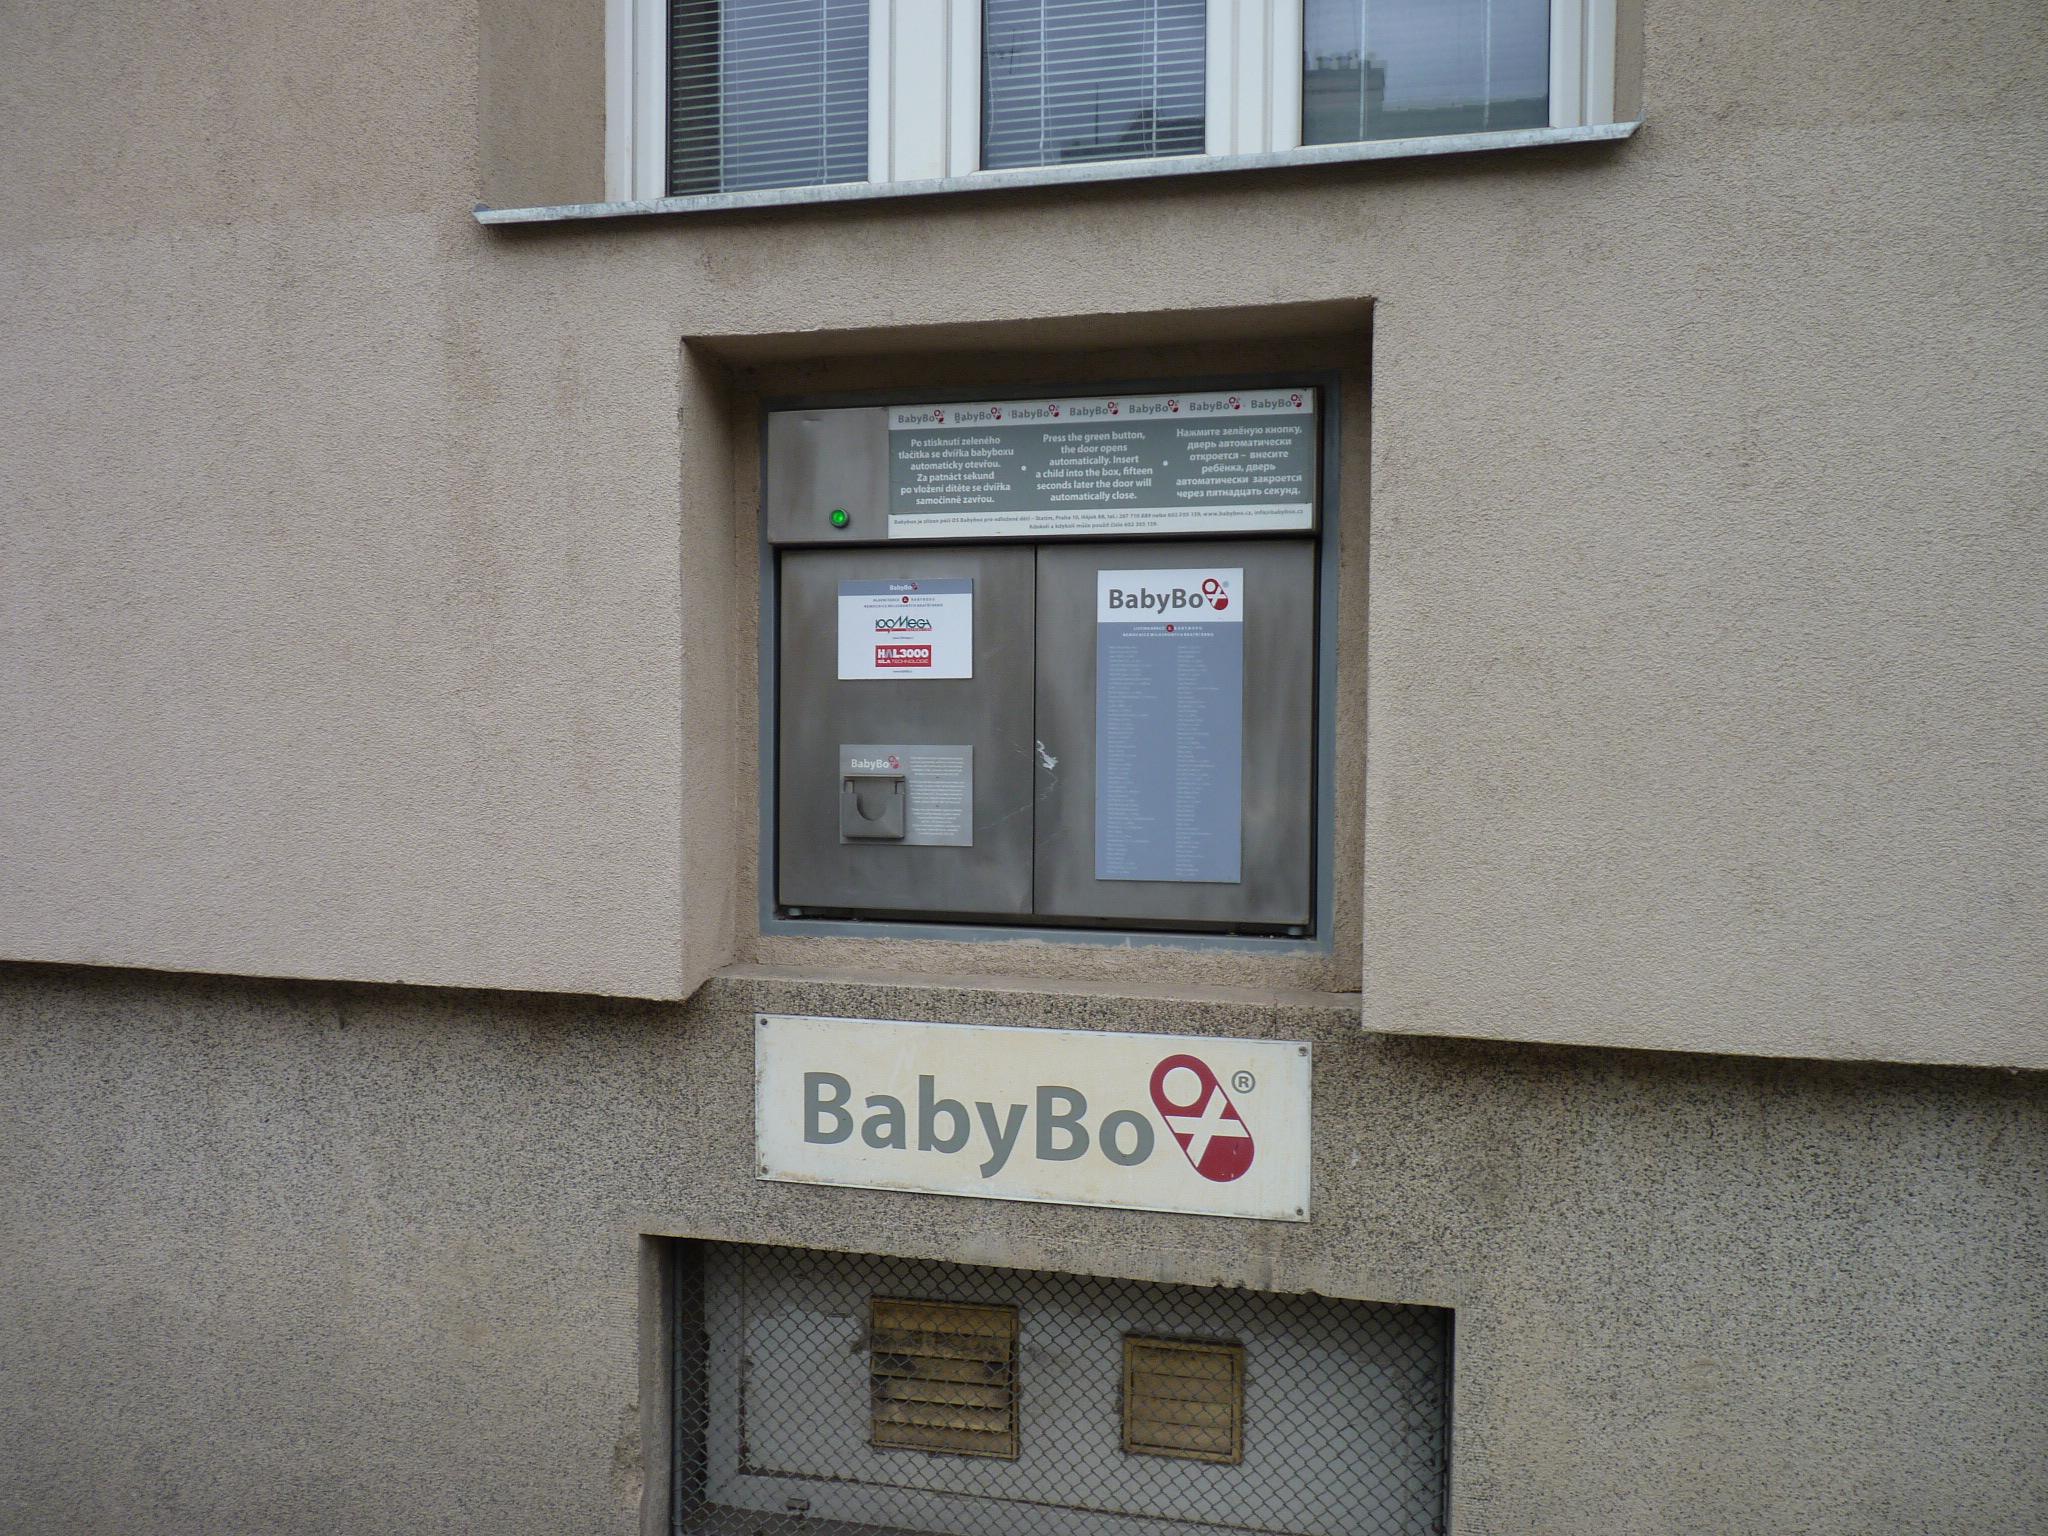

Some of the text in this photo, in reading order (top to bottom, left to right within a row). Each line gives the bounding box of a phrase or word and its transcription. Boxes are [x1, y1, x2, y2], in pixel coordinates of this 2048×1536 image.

[1177, 428, 1220, 436] Нажмите
[1222, 426, 1263, 436] зелёную
[911, 436, 1000, 447] Po stisknutí zeleného
[1043, 434, 1066, 443] Press
[1084, 433, 1110, 442] green
[1112, 431, 1145, 440] button,
[1061, 444, 1127, 454] the door opens
[1187, 439, 1292, 450] дверь автоматически
[899, 450, 929, 459] tlačítka
[942, 449, 969, 457] dvířka
[971, 448, 1014, 457] babyboxu
[1190, 453, 1238, 462] откроется
[910, 460, 1000, 470] automaticky otevřou.
[1049, 456, 1111, 466] automatically.
[1043, 470, 1065, 478] child
[1086, 468, 1100, 476] the
[1102, 468, 1121, 476] box,
[1123, 466, 1152, 475] fifteen
[1246, 463, 1275, 472] дверь
[929, 473, 961, 483] patnáct
[963, 472, 994, 480] sekund
[1176, 475, 1302, 486] автоматически закроется
[901, 487, 911, 495] po
[914, 485, 944, 493] vložení
[946, 484, 970, 492] dítěte
[983, 482, 1011, 491] dvířka
[1037, 478, 1151, 490] seconds later the door will
[1050, 491, 1136, 501] automatically close.
[1177, 487, 1300, 499] через пятнадцать секунд.
[963, 495, 995, 503] zavřou.
